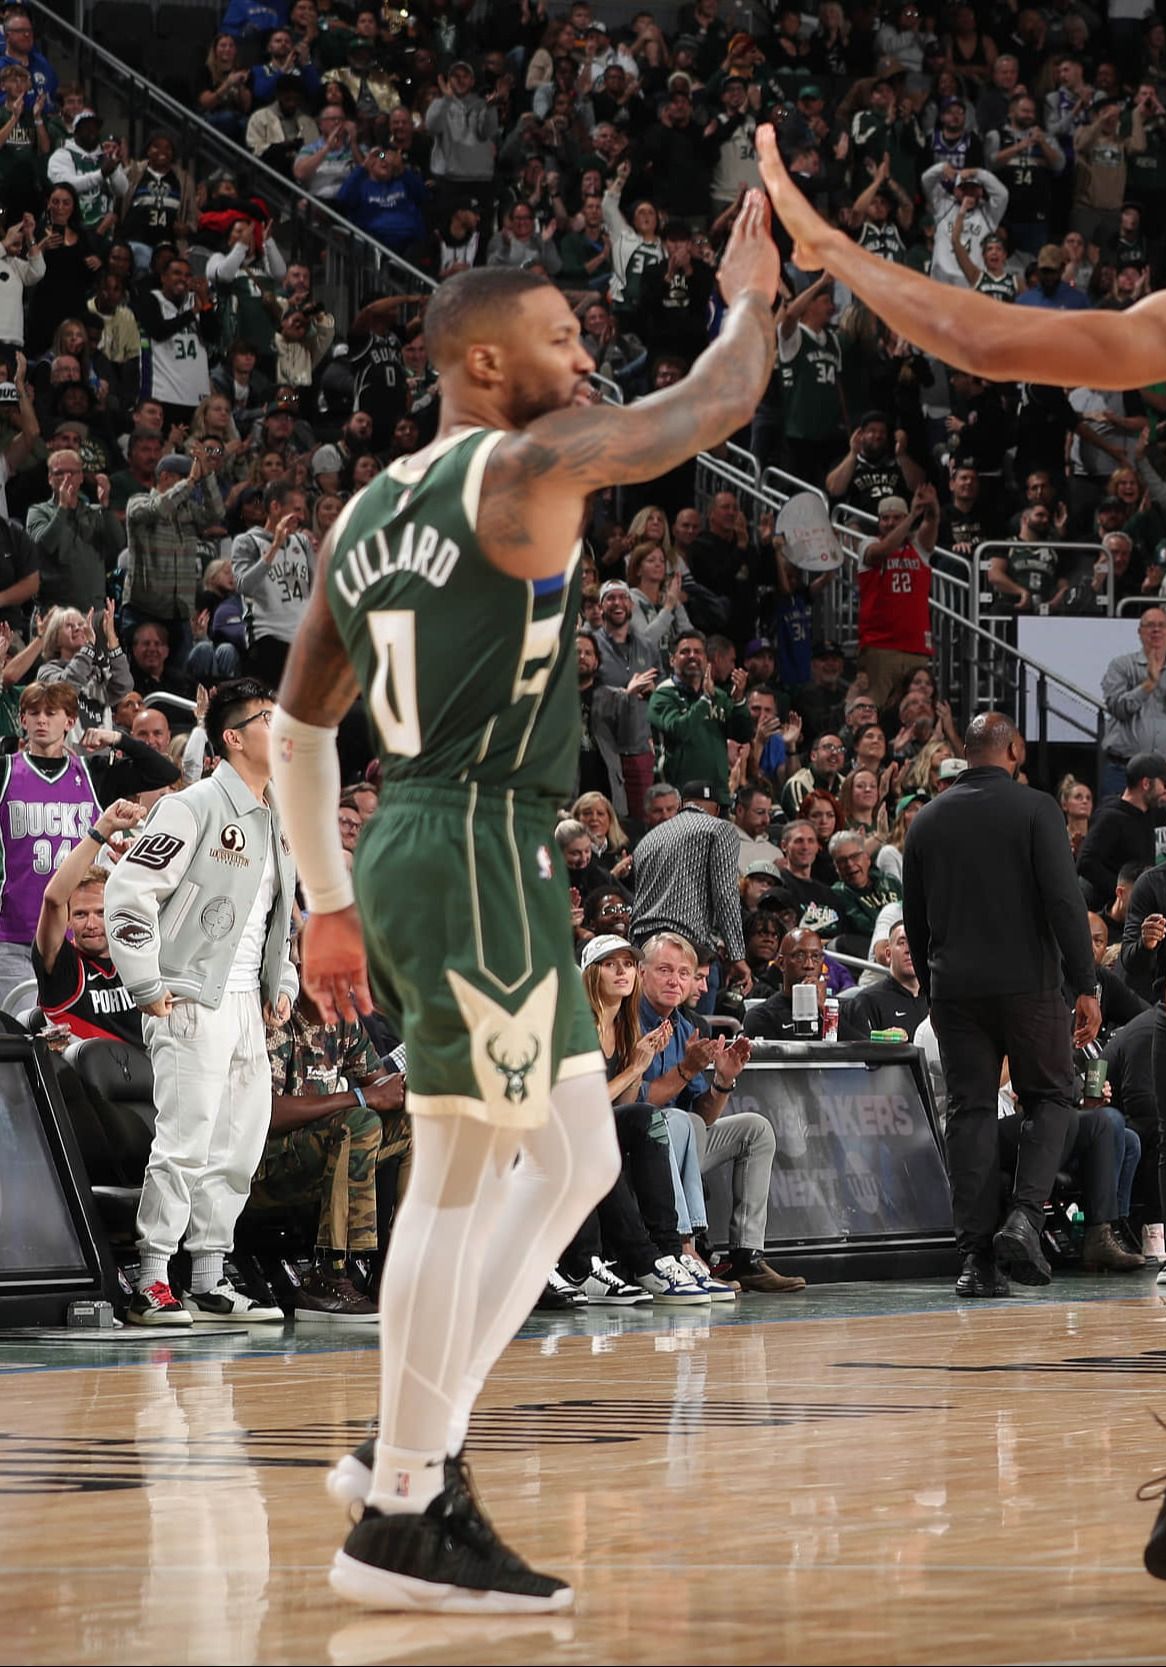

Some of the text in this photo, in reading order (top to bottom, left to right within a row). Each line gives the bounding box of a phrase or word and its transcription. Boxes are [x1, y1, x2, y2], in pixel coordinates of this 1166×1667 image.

[1015, 169, 1033, 185] 34
[147, 209, 168, 227] 34
[174, 339, 198, 360] 34
[385, 366, 397, 387] 0
[816, 362, 837, 385] 34
[854, 472, 899, 491] BUCKS
[267, 562, 307, 582] BUCKS
[335, 521, 461, 609] LILLARD
[277, 579, 303, 602] 34
[891, 572, 912, 594] 22
[366, 609, 422, 759] 0
[89, 987, 137, 1014] PORTL
